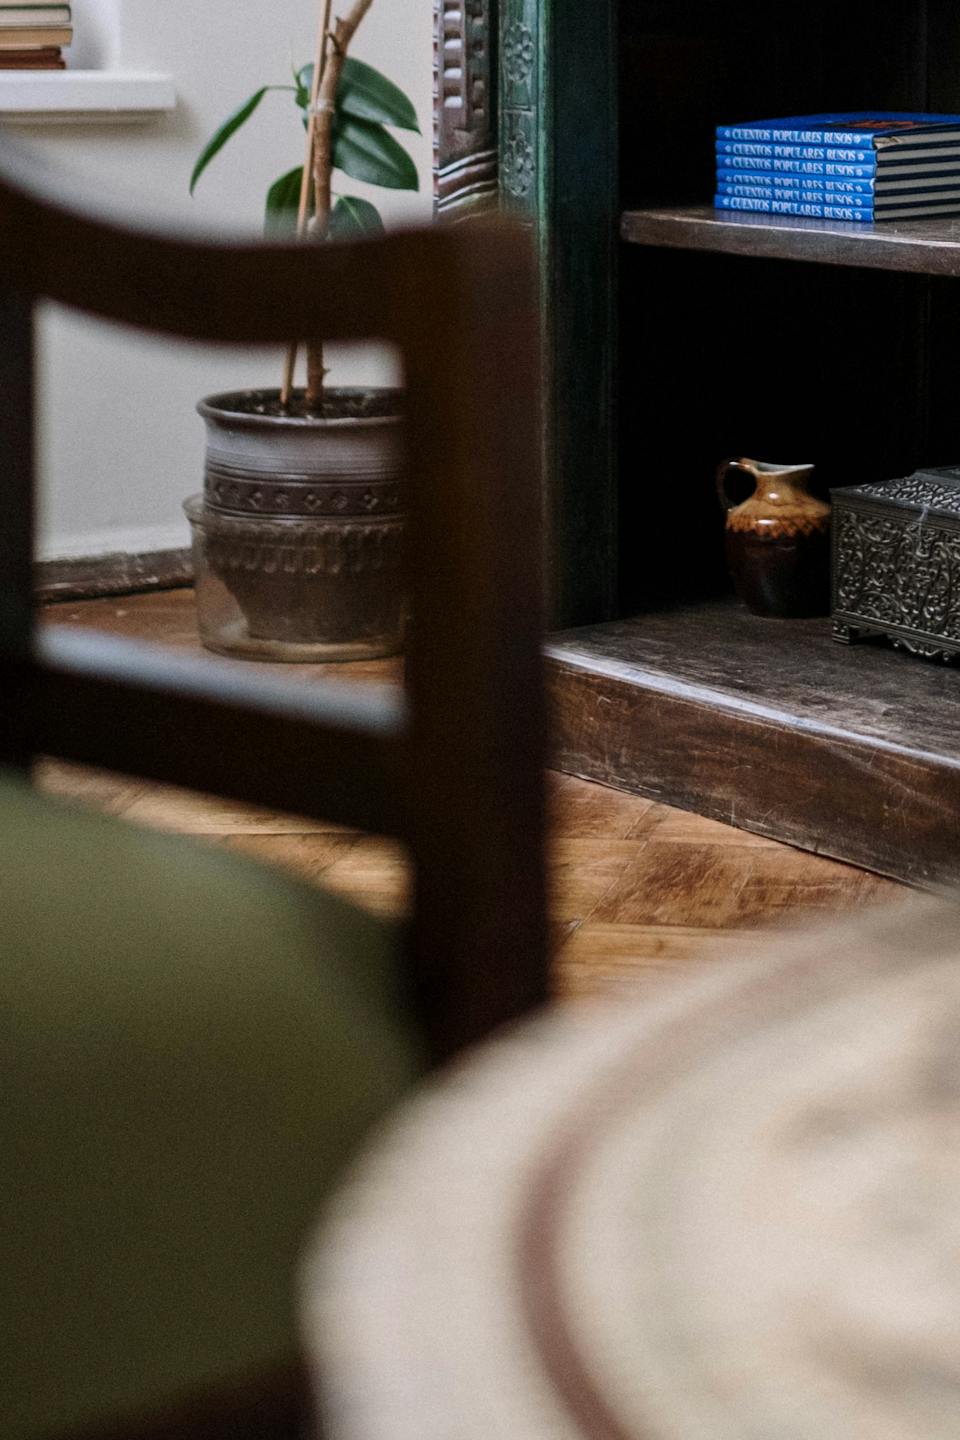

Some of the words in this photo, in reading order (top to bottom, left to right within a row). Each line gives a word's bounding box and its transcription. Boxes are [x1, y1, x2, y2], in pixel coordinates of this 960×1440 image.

[732, 129, 770, 140] CUENTOS
[773, 130, 821, 143] POPULARES
[824, 132, 853, 144] RUSOS
[733, 144, 771, 155] CUENTOS
[774, 146, 824, 159] POPULARES
[827, 149, 855, 161] RUSOS
[733, 157, 772, 169] CUENTOS
[774, 160, 823, 173] POPULARES
[826, 164, 854, 176] RUSOS
[731, 198, 769, 210] CUENTOS
[772, 200, 821, 216] POPULARES
[824, 206, 853, 219] RUSOS
